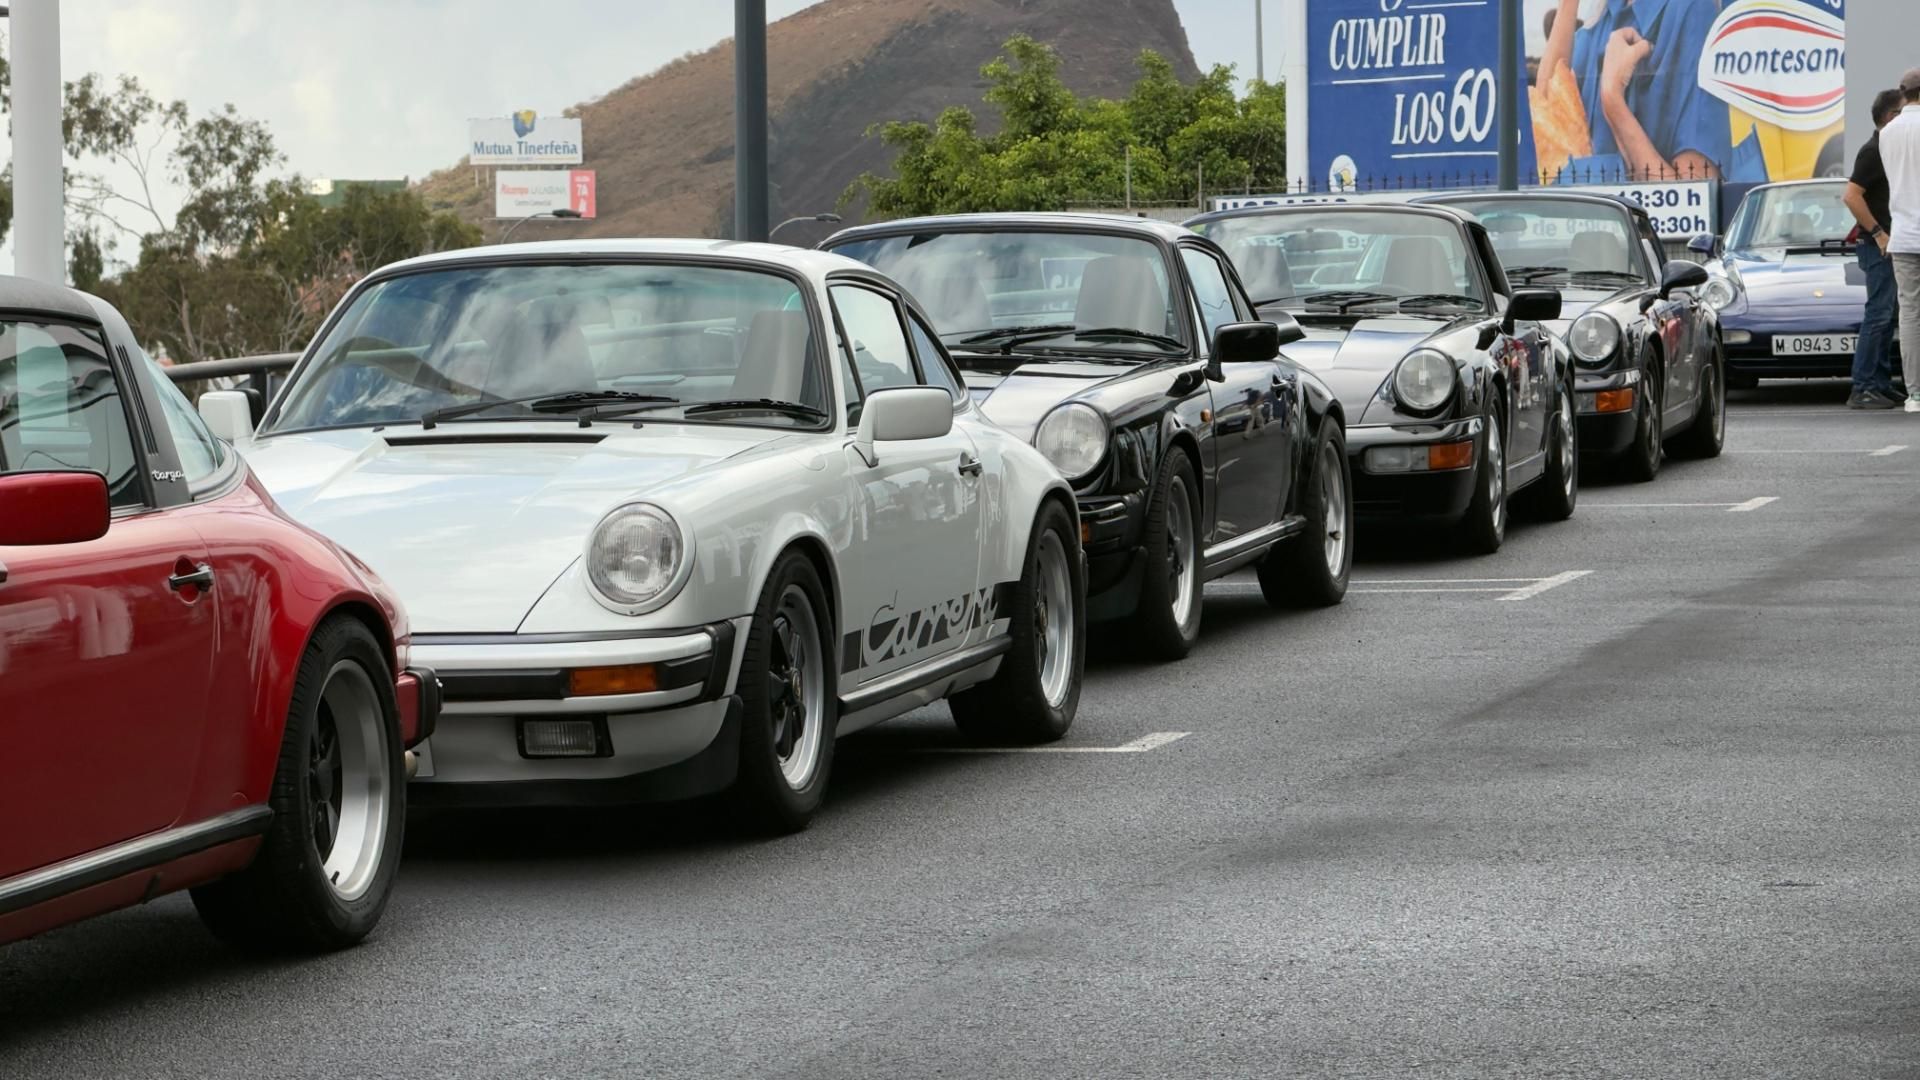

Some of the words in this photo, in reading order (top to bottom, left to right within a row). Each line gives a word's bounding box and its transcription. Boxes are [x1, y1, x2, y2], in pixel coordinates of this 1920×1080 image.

[1329, 13, 1447, 71] CUMPLIR
[1391, 91, 1446, 145] LOS
[1450, 68, 1497, 143] 60
[473, 141, 513, 155] Mutua
[517, 140, 578, 155] Tinerfeña
[1687, 189, 1701, 207] h
[1533, 219, 1557, 237] de
[1775, 338, 1785, 353] M
[1792, 337, 1832, 353] 0943
[1840, 336, 1859, 352] ST
[860, 585, 1000, 667] Carrera
